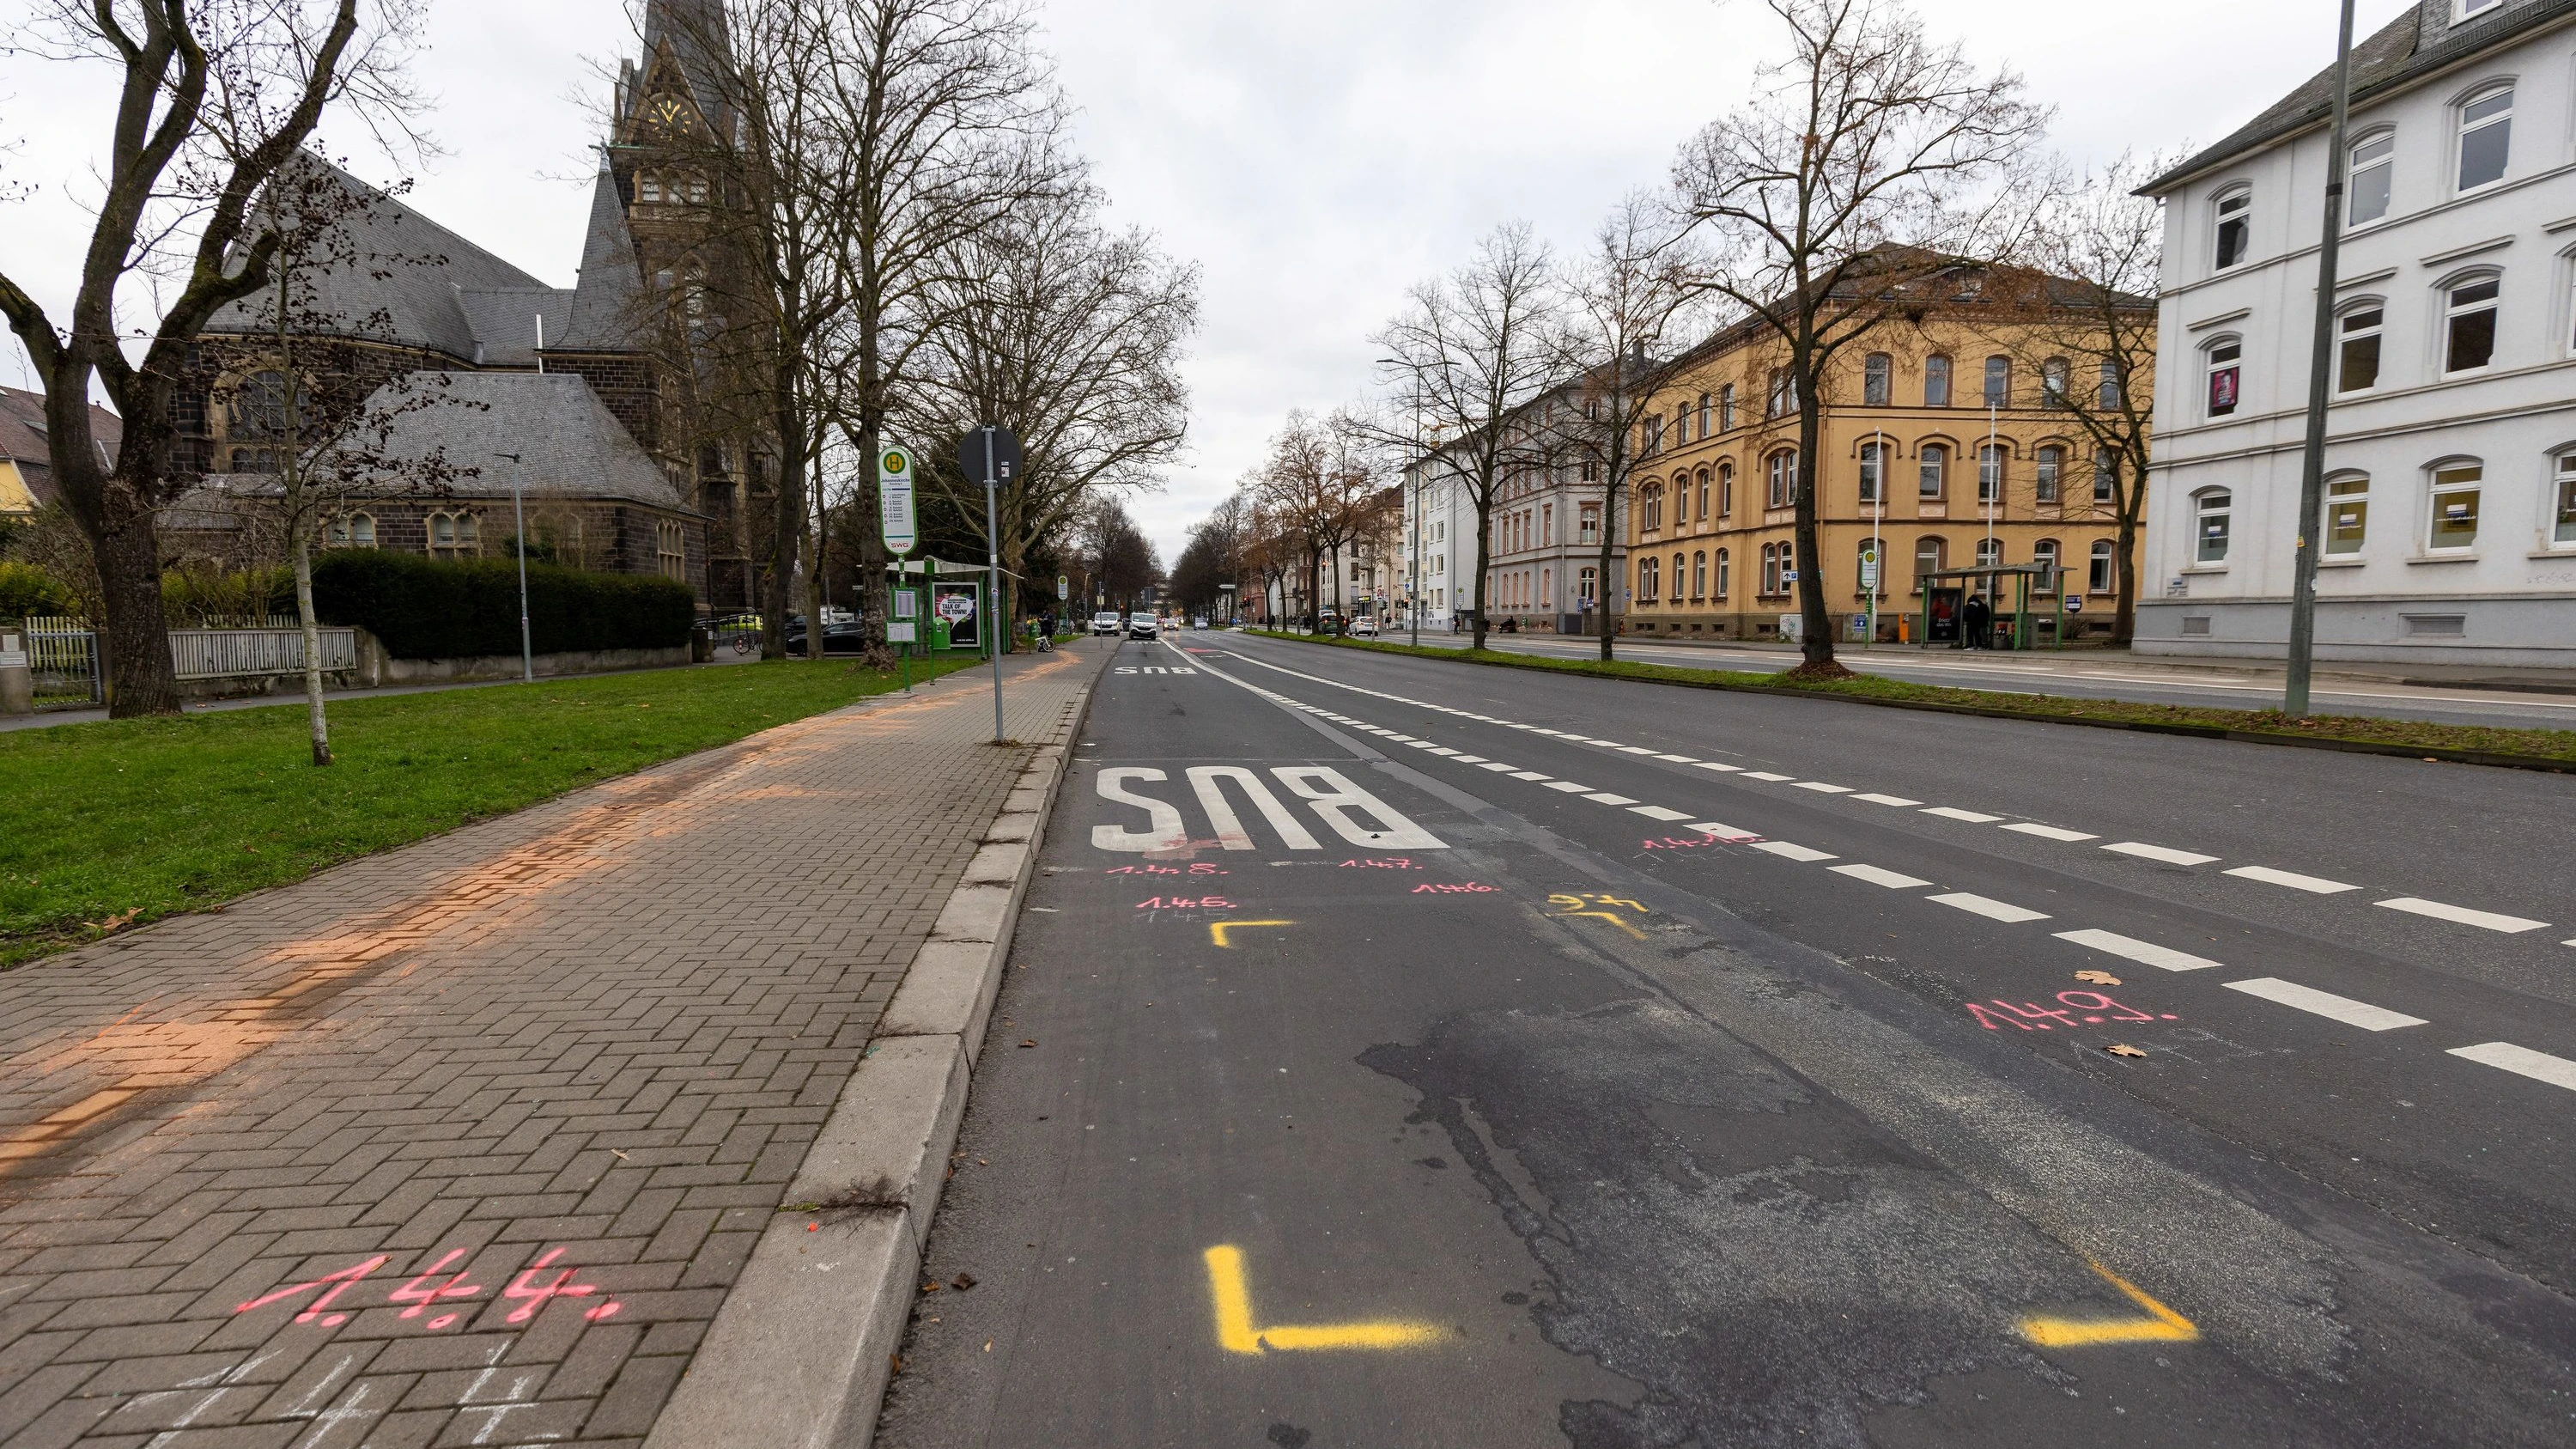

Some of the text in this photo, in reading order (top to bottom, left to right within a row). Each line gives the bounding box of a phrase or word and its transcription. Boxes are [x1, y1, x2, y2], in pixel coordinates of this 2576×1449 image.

[890, 456, 899, 469] H
[1114, 666, 1199, 675] BUS
[1091, 765, 1451, 852] BUS
[1105, 862, 1230, 875] 1.4.8.
[1338, 856, 1425, 869] 1.4.7.
[1134, 896, 1239, 910] 1.4.5.
[1964, 989, 2179, 1032] 1.4.9.
[234, 1245, 624, 1330] 1.4.4.
